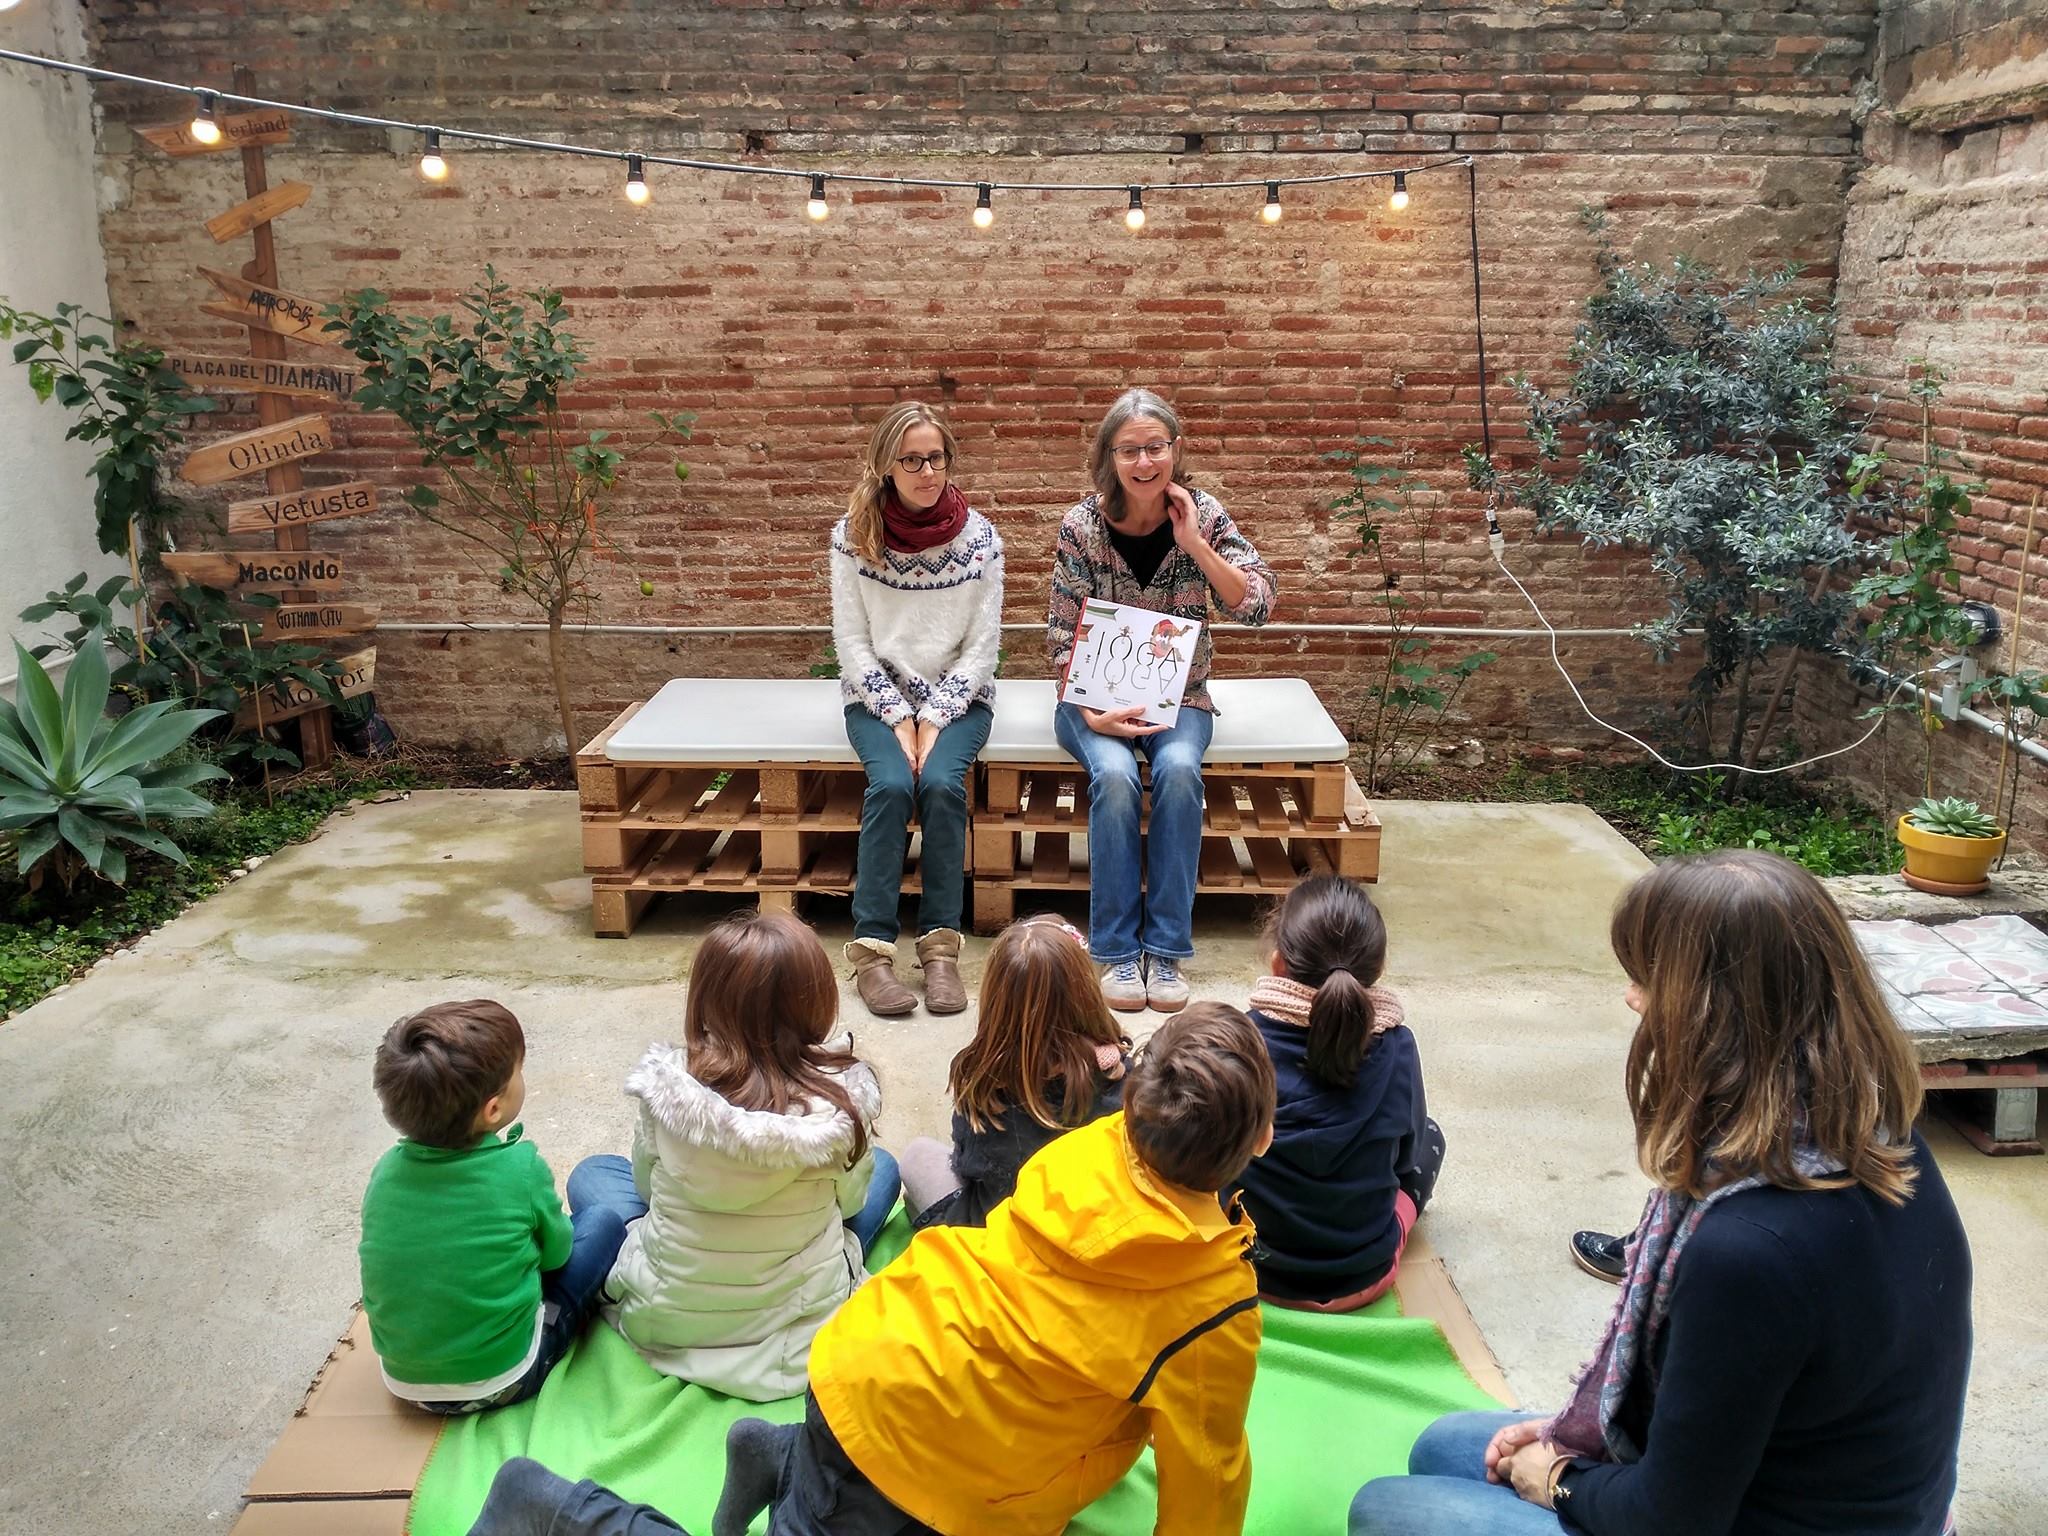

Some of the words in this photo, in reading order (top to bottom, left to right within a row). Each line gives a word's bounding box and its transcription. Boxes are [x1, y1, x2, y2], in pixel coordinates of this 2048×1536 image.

[175, 114, 287, 145] Werland
[172, 358, 226, 377] PLAÇA
[229, 364, 259, 380] DEL
[265, 364, 356, 394] DIAMANT
[262, 489, 370, 525] Vetusta
[238, 559, 339, 583] MacoNdo
[276, 609, 319, 630] GOTHAM
[319, 607, 343, 628] CITY
[268, 667, 366, 713] Moor
